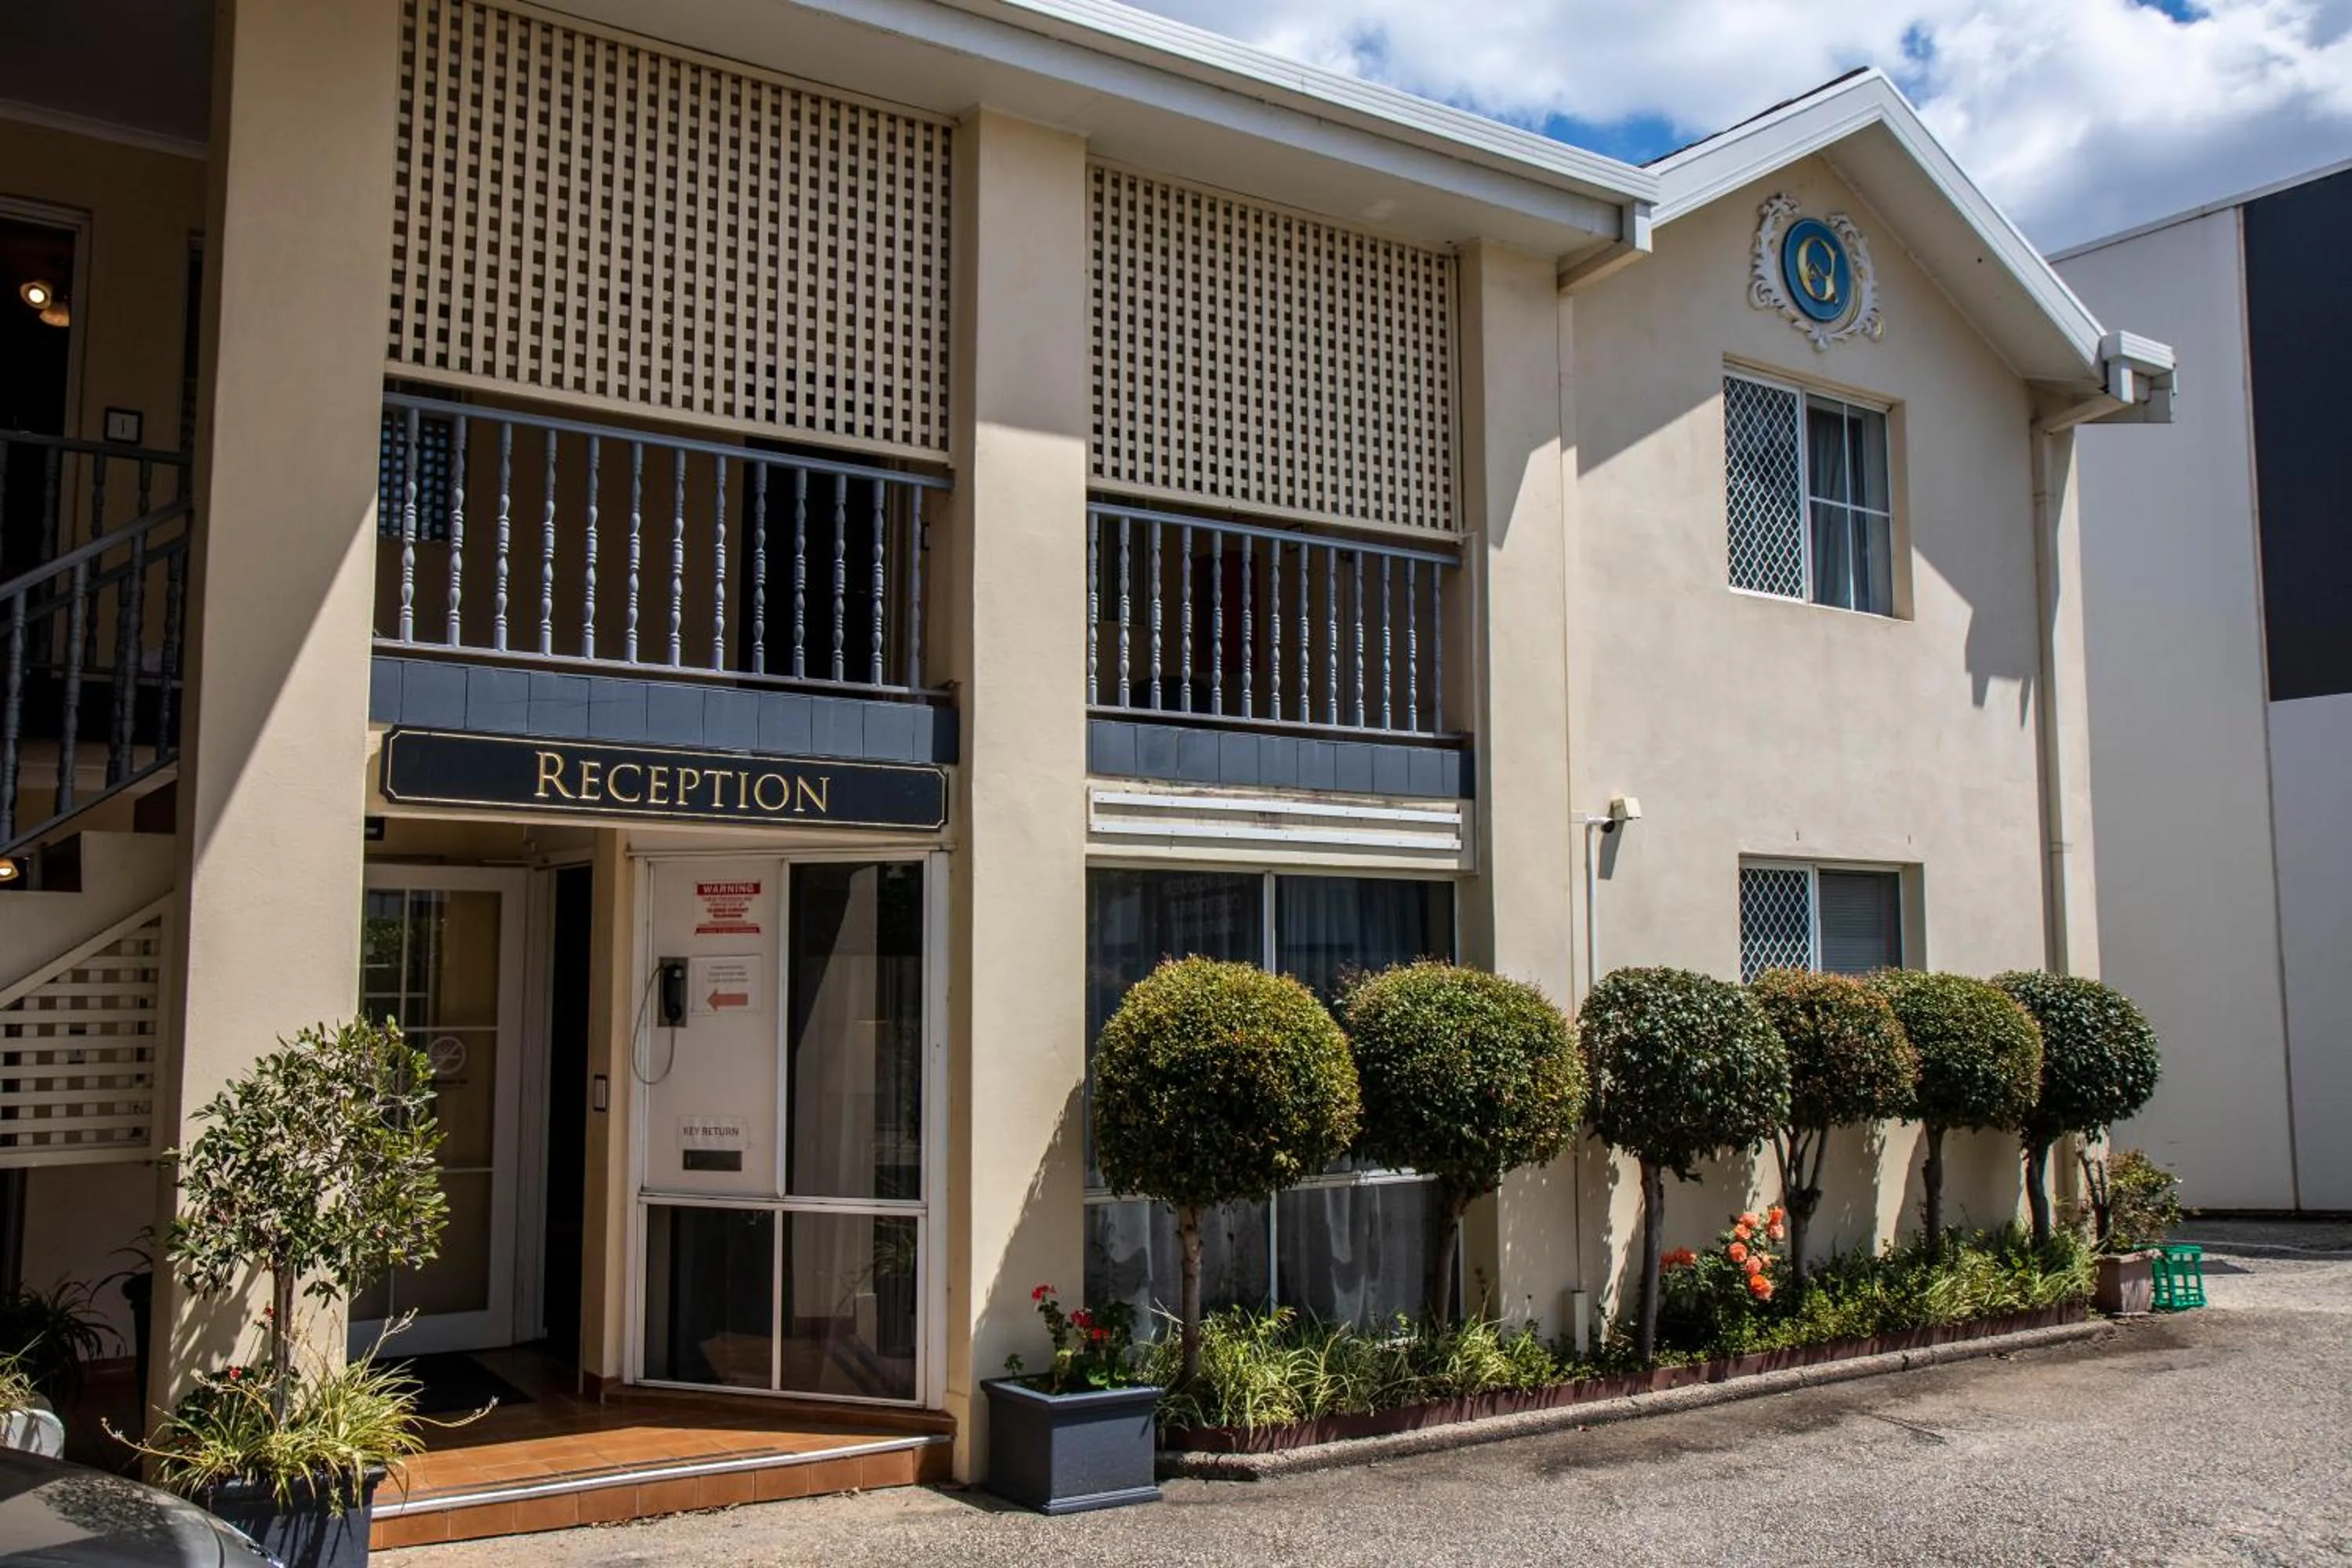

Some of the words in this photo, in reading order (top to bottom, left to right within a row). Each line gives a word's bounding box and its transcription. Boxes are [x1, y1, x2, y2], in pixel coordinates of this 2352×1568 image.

[534, 750, 830, 812] RECEPTION
[702, 883, 755, 893] WARNING
[683, 1126, 700, 1136] KEY
[702, 1127, 739, 1137] RETURN
